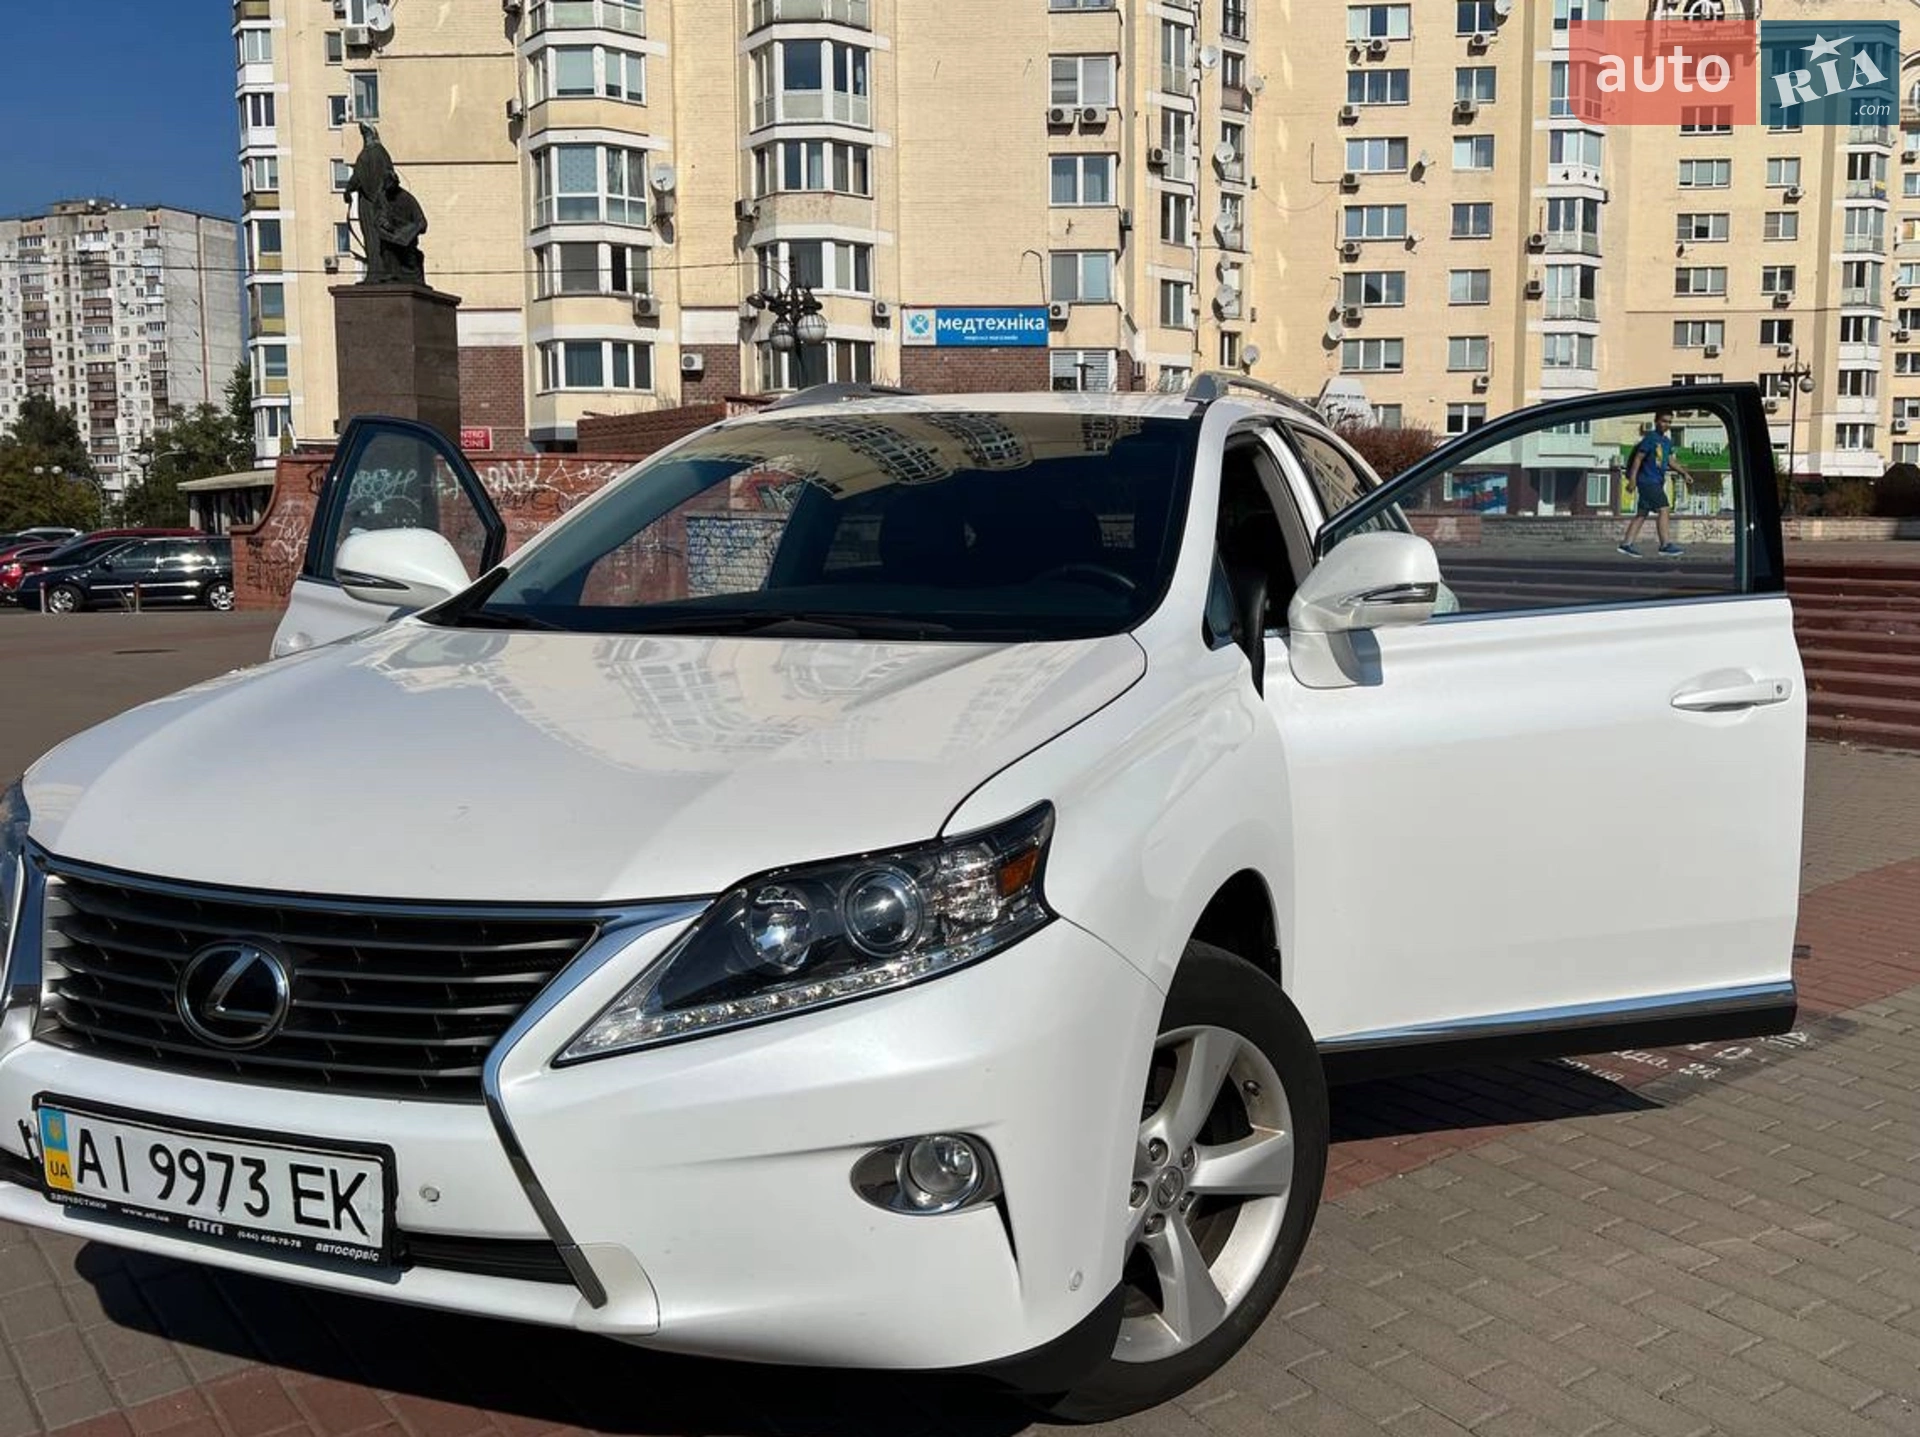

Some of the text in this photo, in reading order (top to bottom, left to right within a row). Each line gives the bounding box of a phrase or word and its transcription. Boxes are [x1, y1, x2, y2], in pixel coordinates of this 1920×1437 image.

[937, 312, 1046, 334] медтехніка
[50, 1160, 70, 1179] UA
[149, 1143, 270, 1218] 9973
